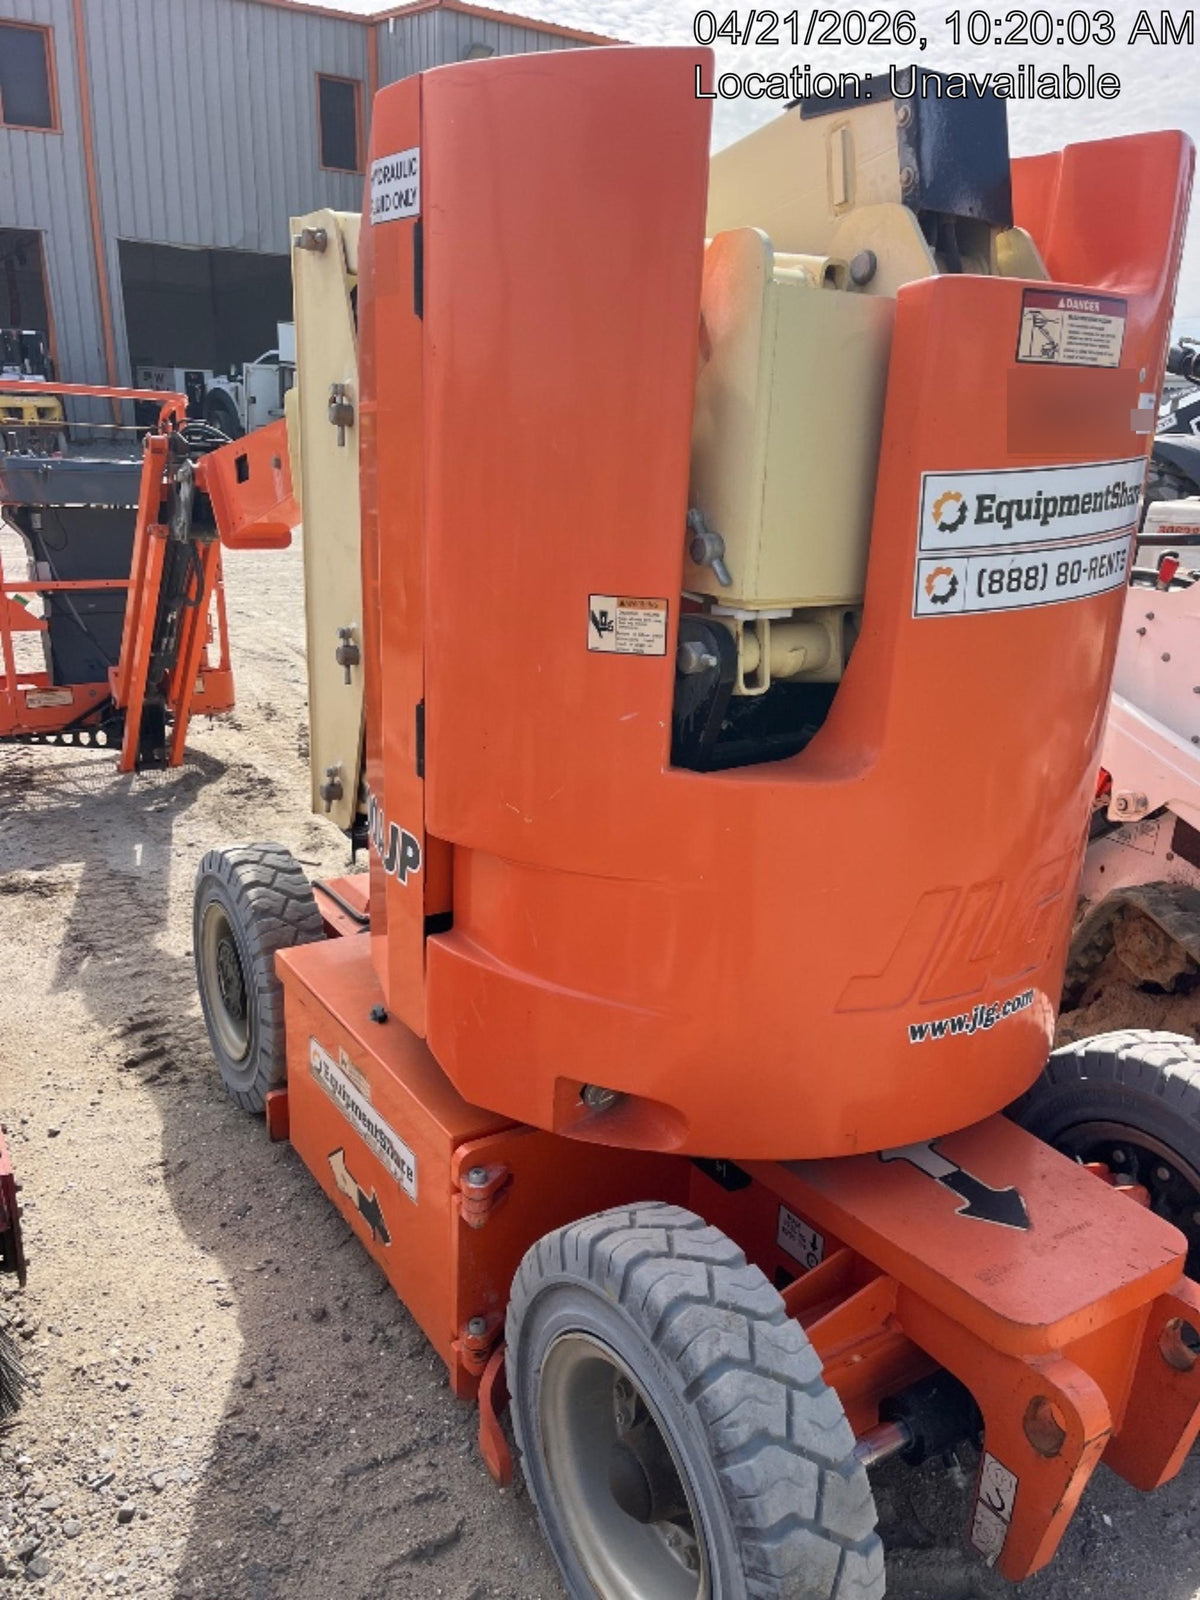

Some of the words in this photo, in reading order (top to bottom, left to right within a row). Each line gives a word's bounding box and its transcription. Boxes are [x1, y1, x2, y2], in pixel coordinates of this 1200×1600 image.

[393, 187, 417, 210] ONLY
[974, 481, 1141, 530] EquipmentShar
[976, 562, 1048, 598] (888)
[908, 987, 1035, 1044] www.jlg.com
[322, 1060, 414, 1184] EquipmentShare
